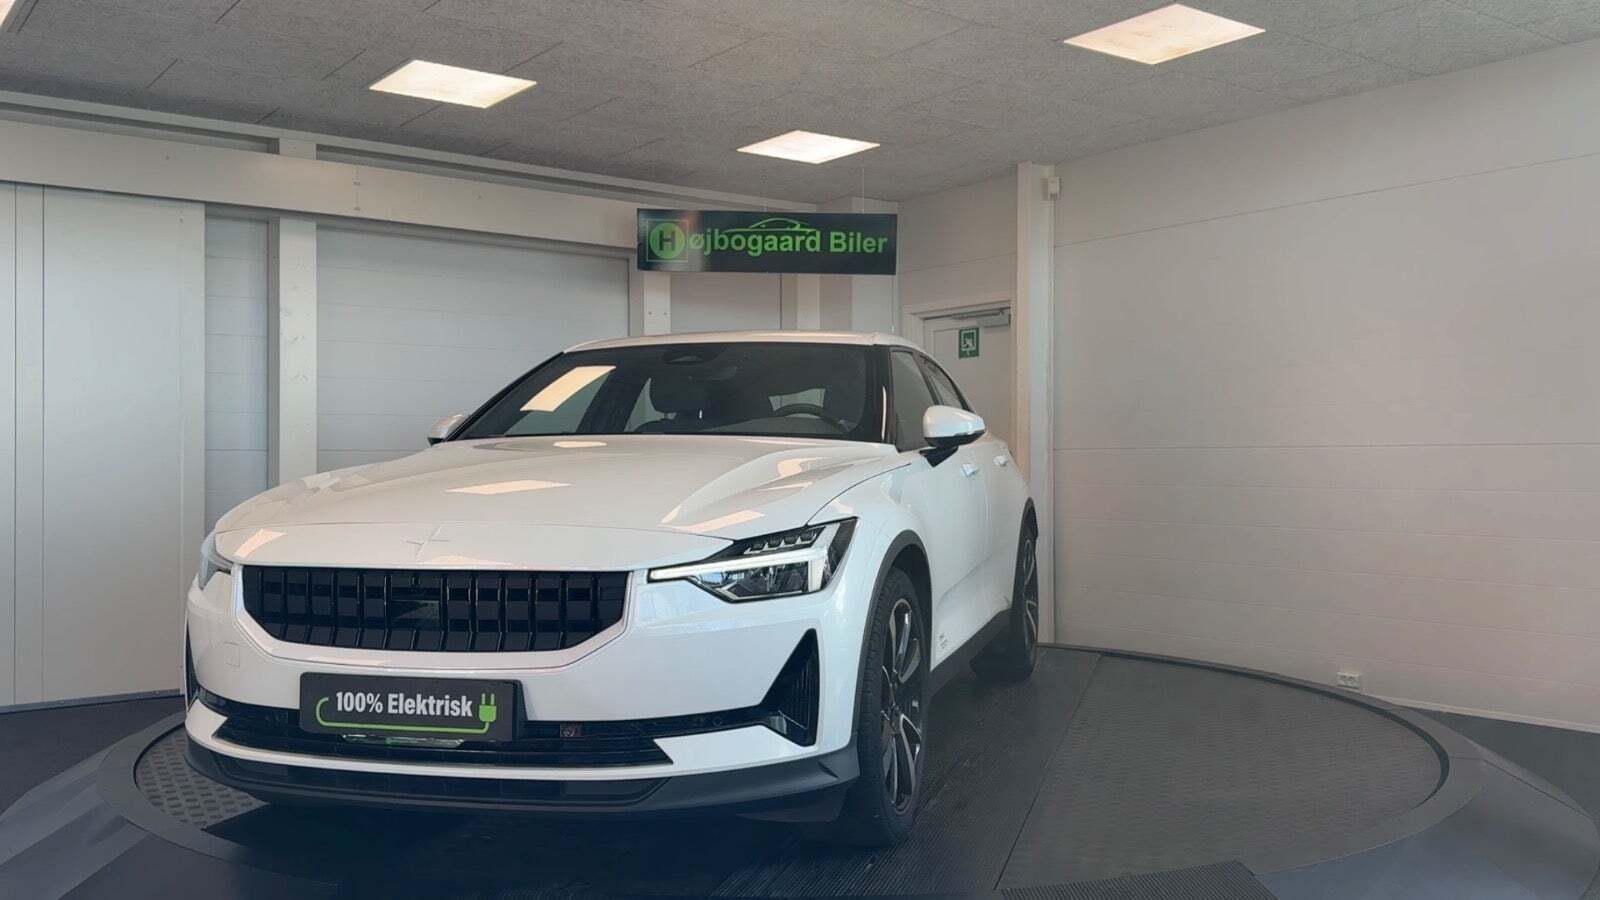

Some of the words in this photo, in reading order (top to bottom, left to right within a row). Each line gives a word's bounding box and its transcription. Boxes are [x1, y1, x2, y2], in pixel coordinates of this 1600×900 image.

[829, 231, 888, 253] Biler
[336, 691, 384, 714] 100%
[387, 693, 473, 717] Elektrisk
